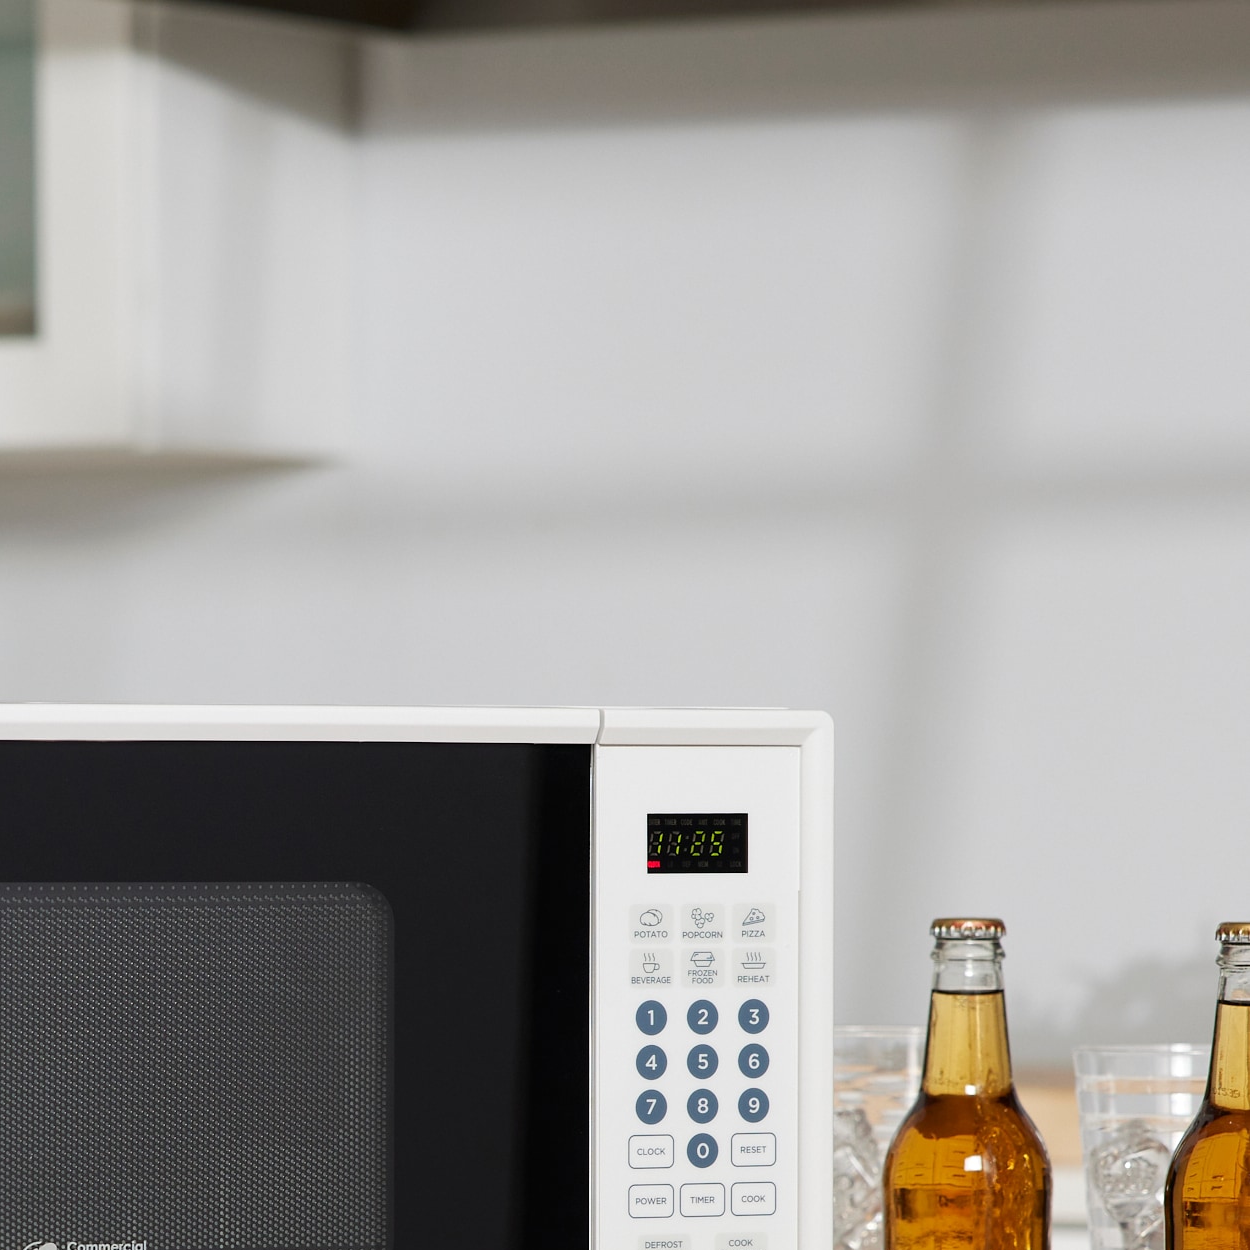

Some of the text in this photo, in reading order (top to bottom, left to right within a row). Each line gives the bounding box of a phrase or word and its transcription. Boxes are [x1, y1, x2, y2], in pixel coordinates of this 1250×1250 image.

[634, 931, 669, 939] POTATO
[683, 931, 723, 939] POPCORN
[742, 930, 766, 938] PIZZA
[631, 977, 672, 985] BEVERAGE
[648, 1010, 654, 1025] 1
[698, 1009, 708, 1024] 2
[749, 1009, 759, 1024] 3
[646, 1055, 657, 1070] 4
[698, 1054, 708, 1069] 5
[749, 1053, 759, 1069] 6
[646, 1099, 656, 1114] 7
[698, 1098, 708, 1113] 8
[749, 1098, 759, 1113] 9
[637, 1148, 666, 1156] CLOCK
[697, 1143, 709, 1158] 0
[741, 1146, 767, 1154] RESET
[741, 1195, 766, 1203] COOK
[645, 1241, 683, 1250] DEFROST
[729, 1240, 754, 1248] COOK
